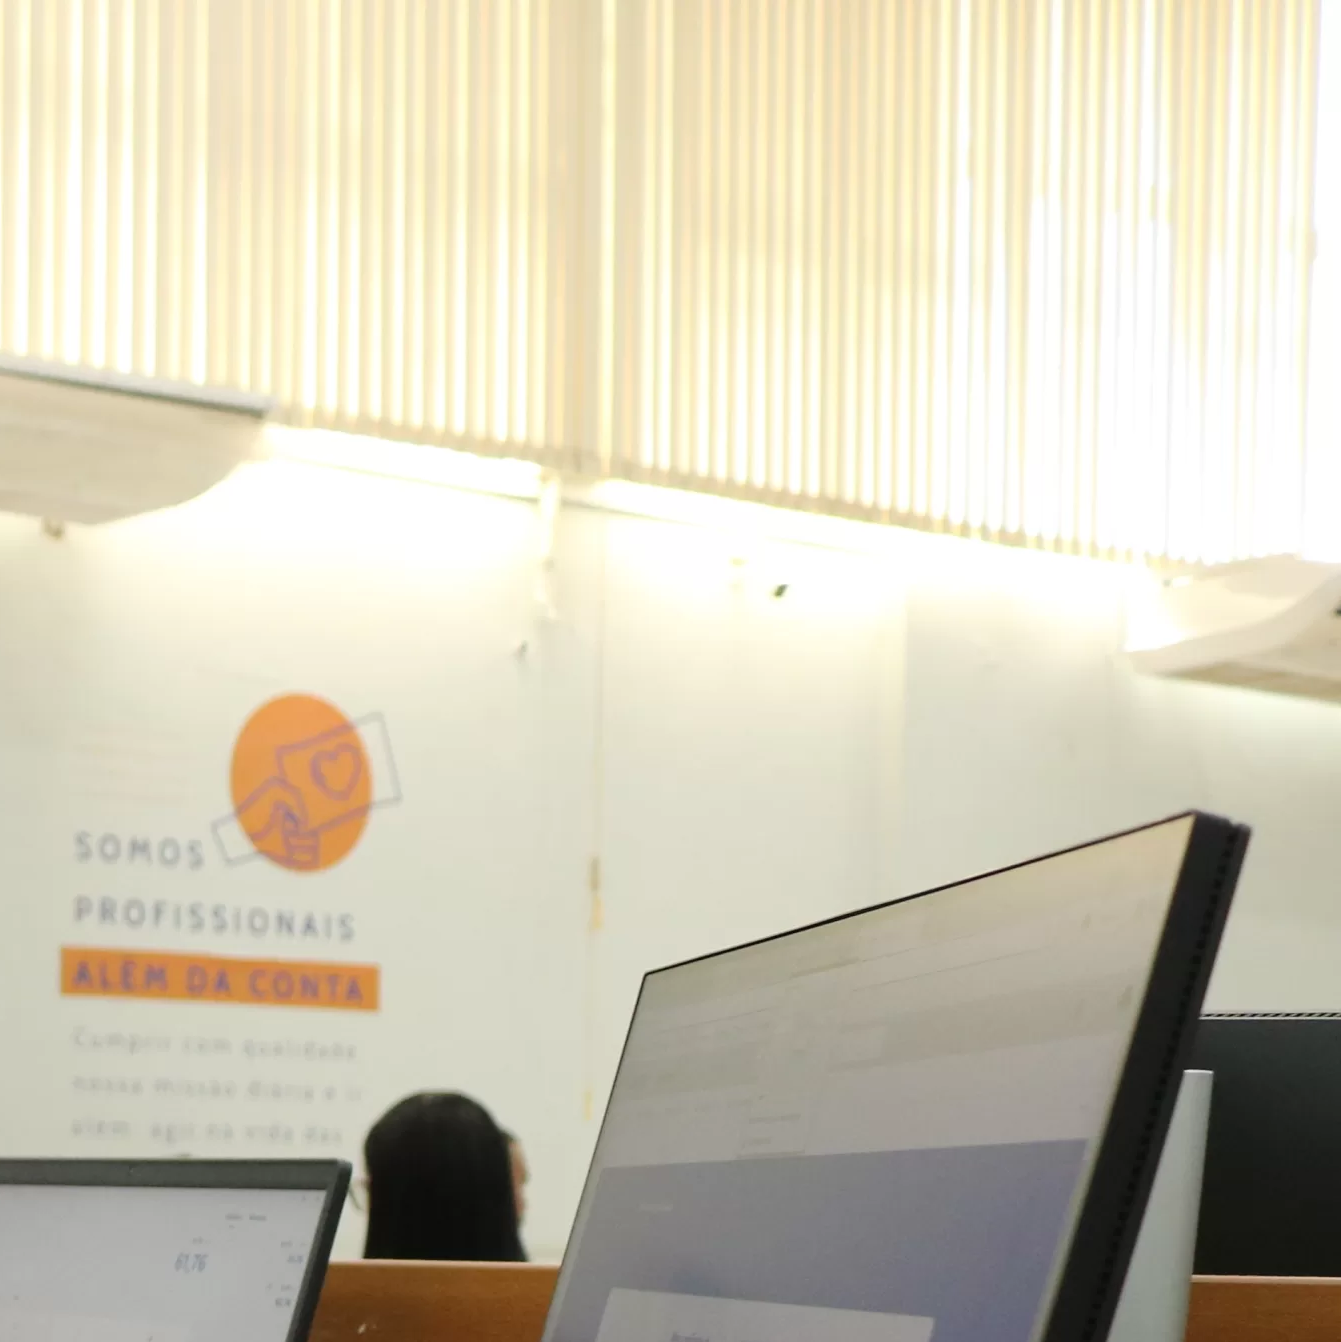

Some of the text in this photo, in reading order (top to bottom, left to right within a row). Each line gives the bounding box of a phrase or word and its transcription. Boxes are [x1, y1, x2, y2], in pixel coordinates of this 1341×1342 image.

[74, 831, 205, 870] SOMOS
[73, 895, 355, 942] PROFISSIONAIS
[186, 963, 230, 997] DA
[248, 967, 363, 1001] CONTA
